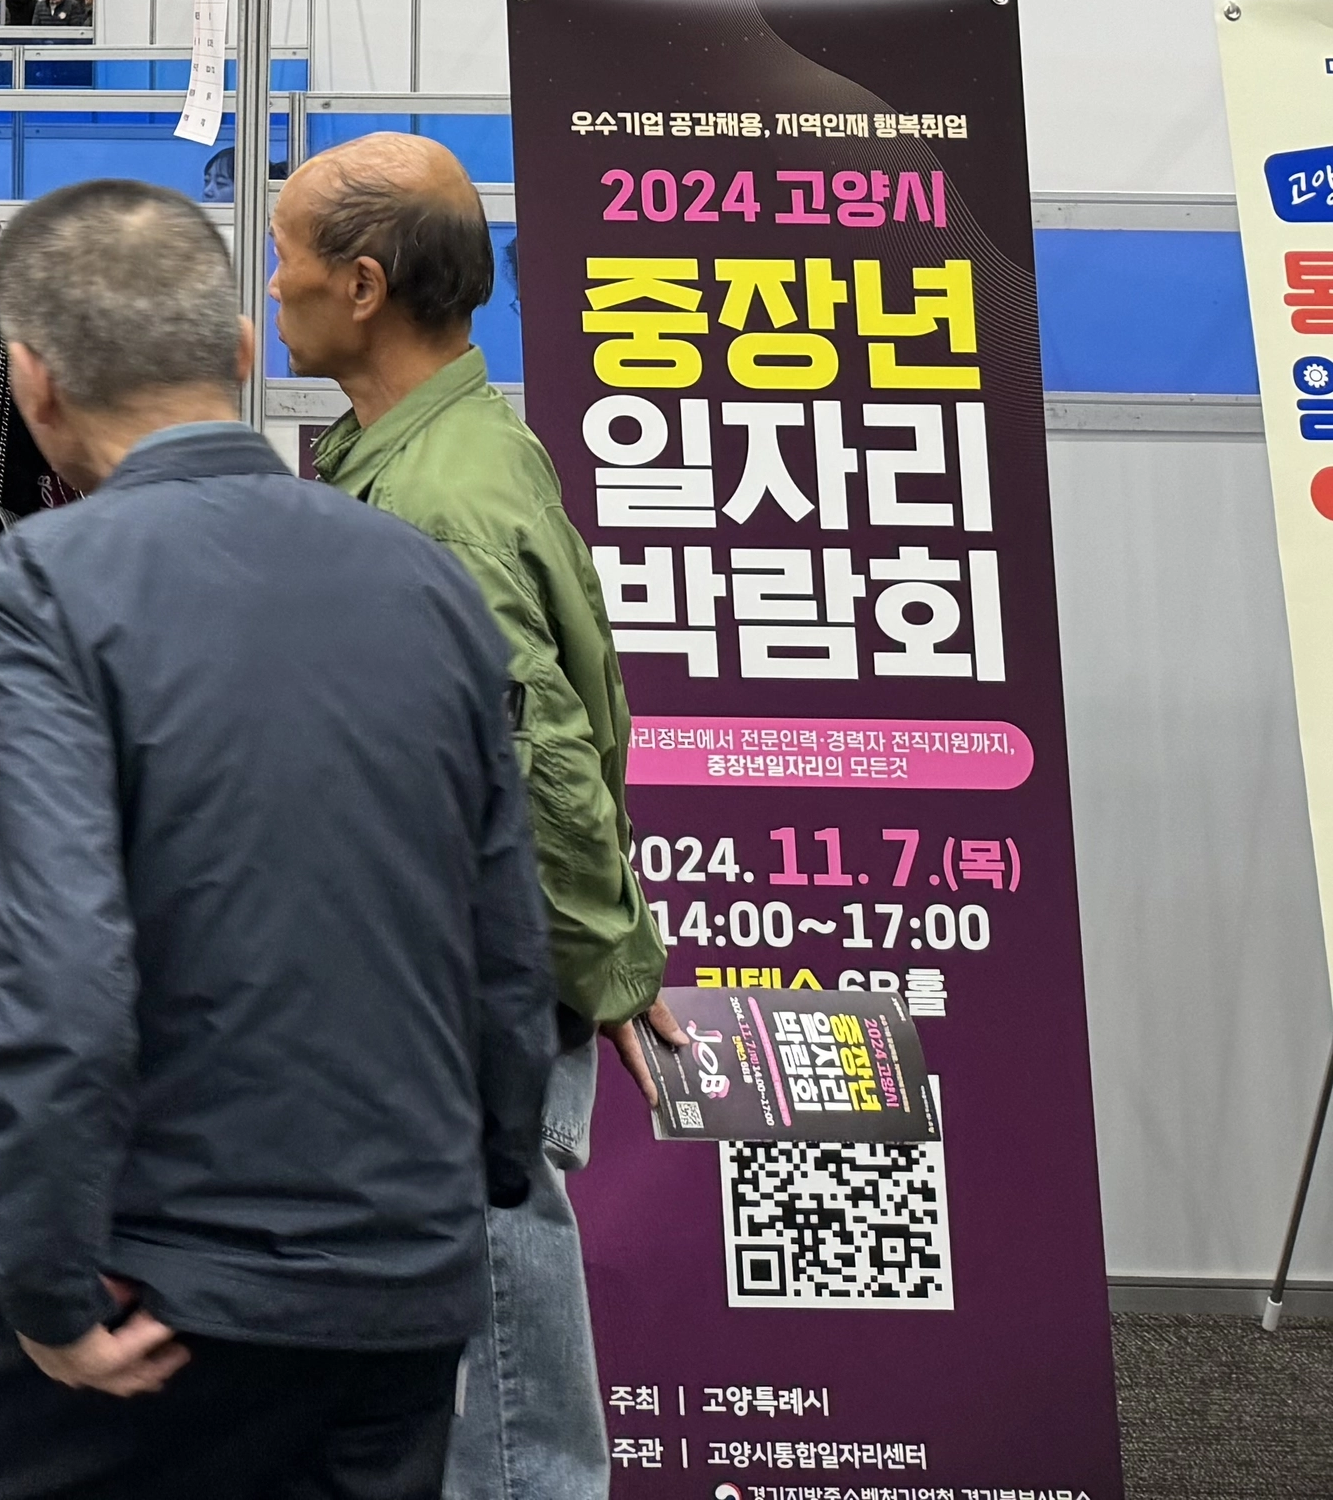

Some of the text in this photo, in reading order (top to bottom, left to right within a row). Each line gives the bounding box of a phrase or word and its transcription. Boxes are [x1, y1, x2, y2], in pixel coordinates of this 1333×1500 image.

[571, 112, 967, 138] 우수기업 공감채용, 지역인재 행복취업
[601, 169, 947, 227] 2024 고양시
[582, 258, 981, 389] 중장년
[583, 395, 992, 531] 일자리
[592, 545, 1006, 682] 박람회
[708, 755, 907, 778] 중장년일자리의 모든것
[741, 730, 885, 752] 전문인력·경력자
[892, 732, 1014, 754] 전직지원까지,
[629, 828, 1020, 892] 024. 11. 7.(목)
[650, 901, 990, 950] 14:00~17:00
[687, 1019, 731, 1099] JOB
[773, 1011, 823, 1112] 박람회
[798, 1012, 854, 1112] 일자리
[829, 1013, 882, 1112] 중장년
[864, 1018, 887, 1060] 2024
[876, 1061, 900, 1109] 고양시
[609, 1386, 829, 1417] 주최 고양특례시
[612, 1438, 926, 1470] 주관 고양시통합일자리센터
